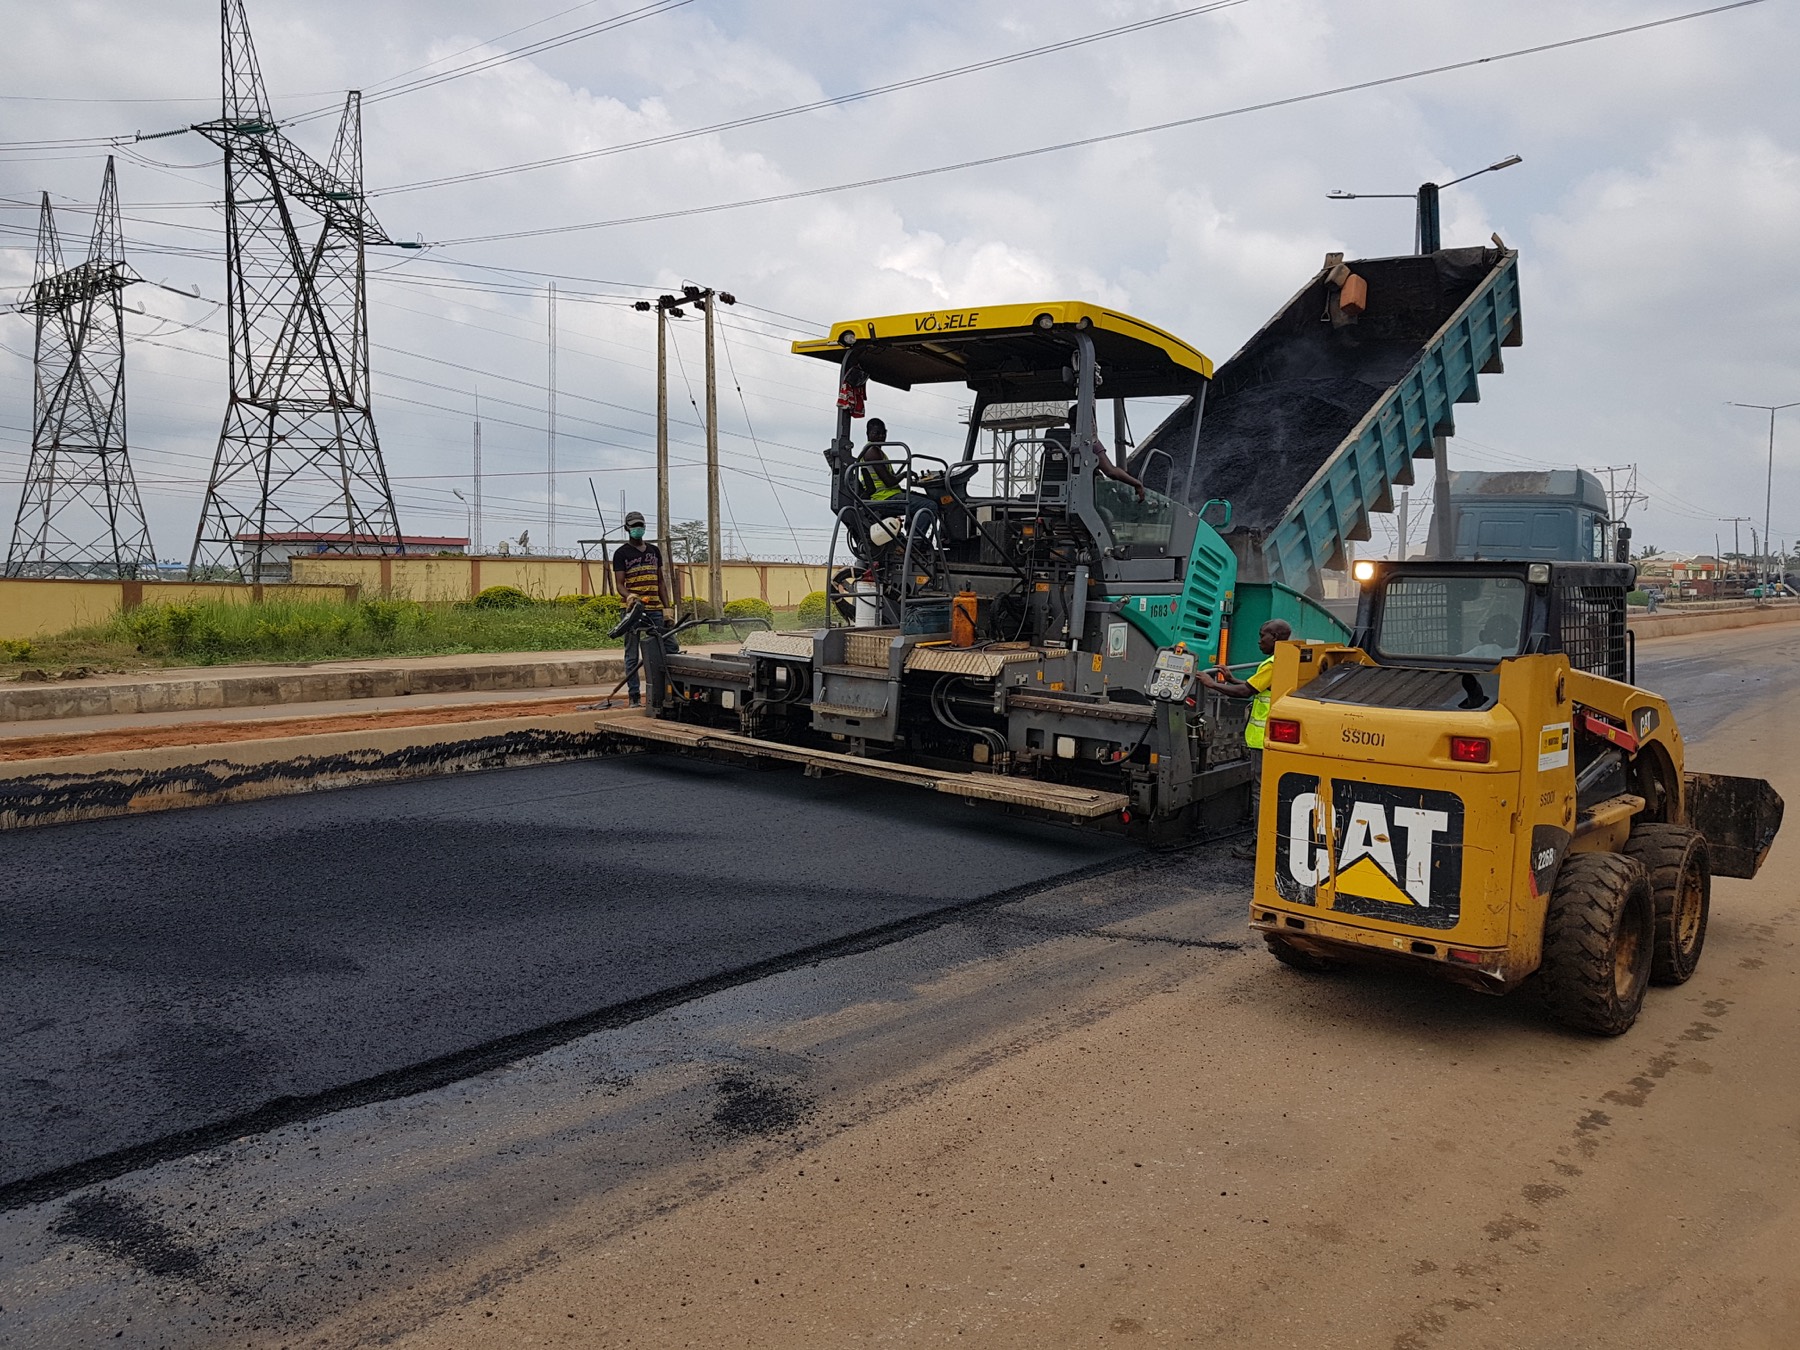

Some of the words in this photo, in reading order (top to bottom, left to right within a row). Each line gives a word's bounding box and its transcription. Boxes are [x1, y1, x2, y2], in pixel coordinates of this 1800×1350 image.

[1640, 710, 1651, 738] CAT
[1342, 729, 1385, 747] SS001
[1289, 792, 1448, 908] CAT
[1537, 847, 1554, 870] 226B
